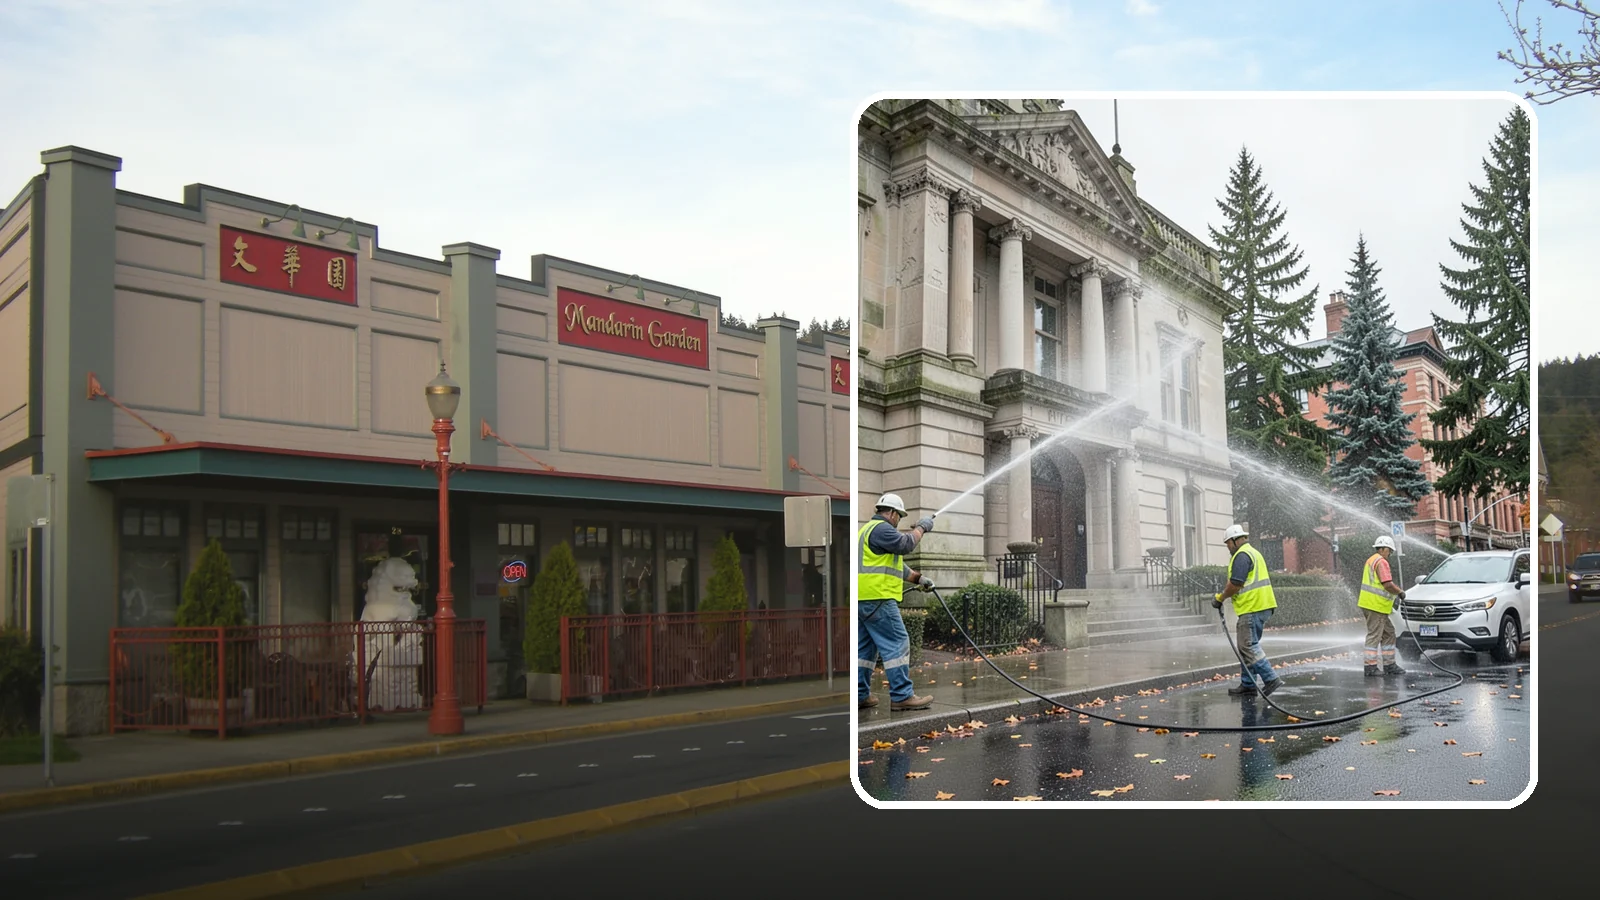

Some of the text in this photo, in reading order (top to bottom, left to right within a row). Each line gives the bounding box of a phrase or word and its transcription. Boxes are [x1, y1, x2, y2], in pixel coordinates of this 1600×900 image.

[231, 235, 346, 291] 文華園
[564, 302, 702, 352] Mandarin Garden
[503, 565, 527, 578] OPEN
